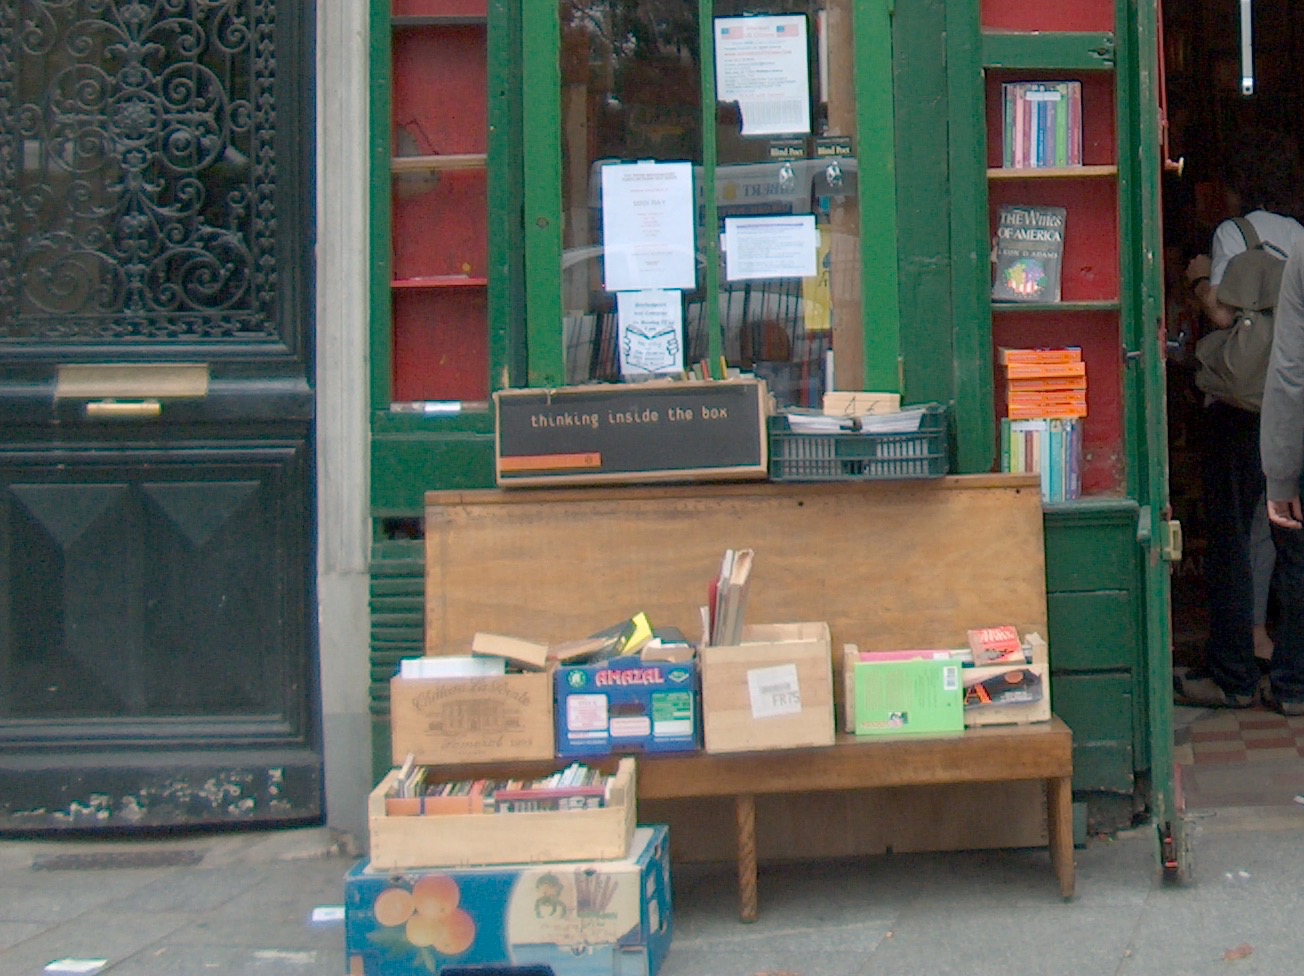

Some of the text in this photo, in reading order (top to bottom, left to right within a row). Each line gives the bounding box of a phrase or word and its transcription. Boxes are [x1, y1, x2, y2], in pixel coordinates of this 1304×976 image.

[1000, 208, 1062, 227] THE Wines
[997, 227, 1061, 241] OF AMERICA
[531, 405, 728, 429] thinking inside the box
